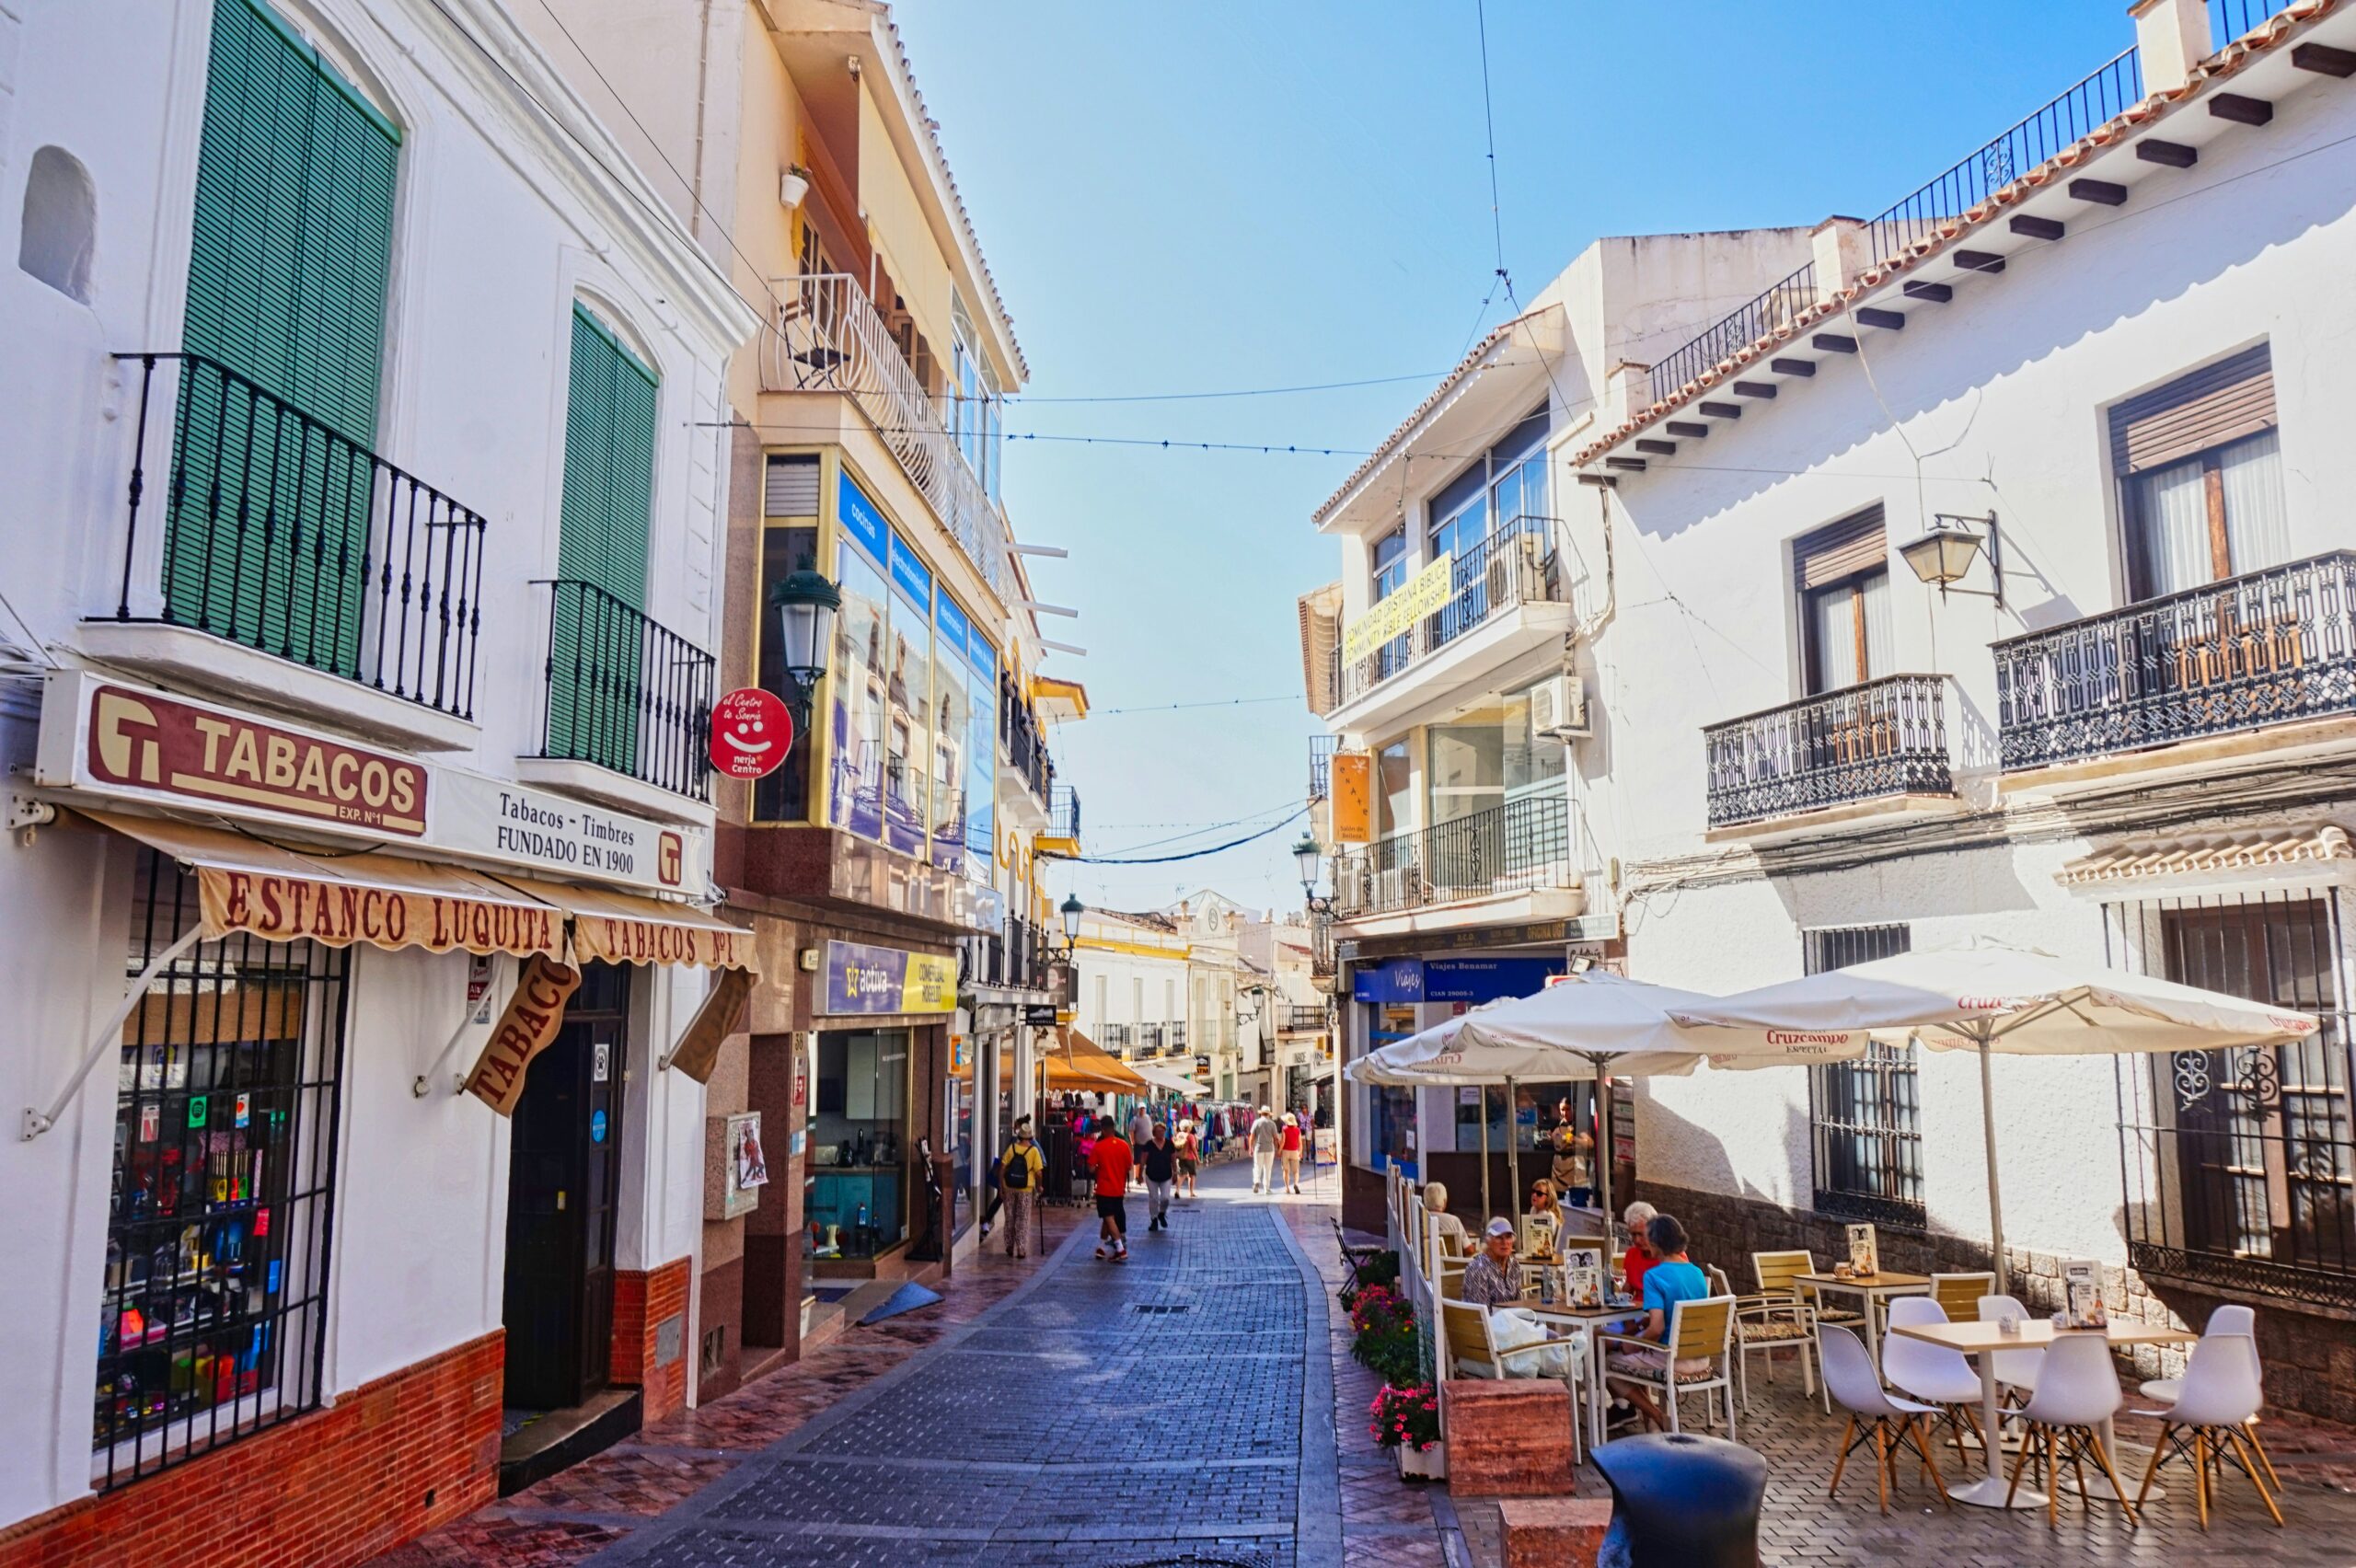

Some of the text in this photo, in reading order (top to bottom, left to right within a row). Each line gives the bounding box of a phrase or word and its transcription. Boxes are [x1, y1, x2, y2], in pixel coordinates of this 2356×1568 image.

[851, 503, 875, 539] cocinas
[1383, 584, 1417, 618] CRISTIANA
[1403, 582, 1447, 622] FELLOWSHIP
[734, 693, 763, 708] Centro
[196, 715, 416, 813] TABACOS
[732, 765, 762, 774] Centro
[733, 755, 756, 767] nerja
[340, 806, 361, 823] EXP.
[500, 792, 563, 829] Tabacos
[583, 814, 634, 846] Timbres
[497, 825, 633, 874] FUNDADO EN 1900
[225, 871, 552, 950] ESTANCO LUQUITA
[606, 919, 696, 962] TABACOS
[860, 963, 887, 993] activa
[1394, 969, 1421, 993] Viajes
[1430, 963, 1456, 972] Viajes
[794, 1032, 803, 1051] 38
[1766, 1030, 1849, 1044] Cruzcampo
